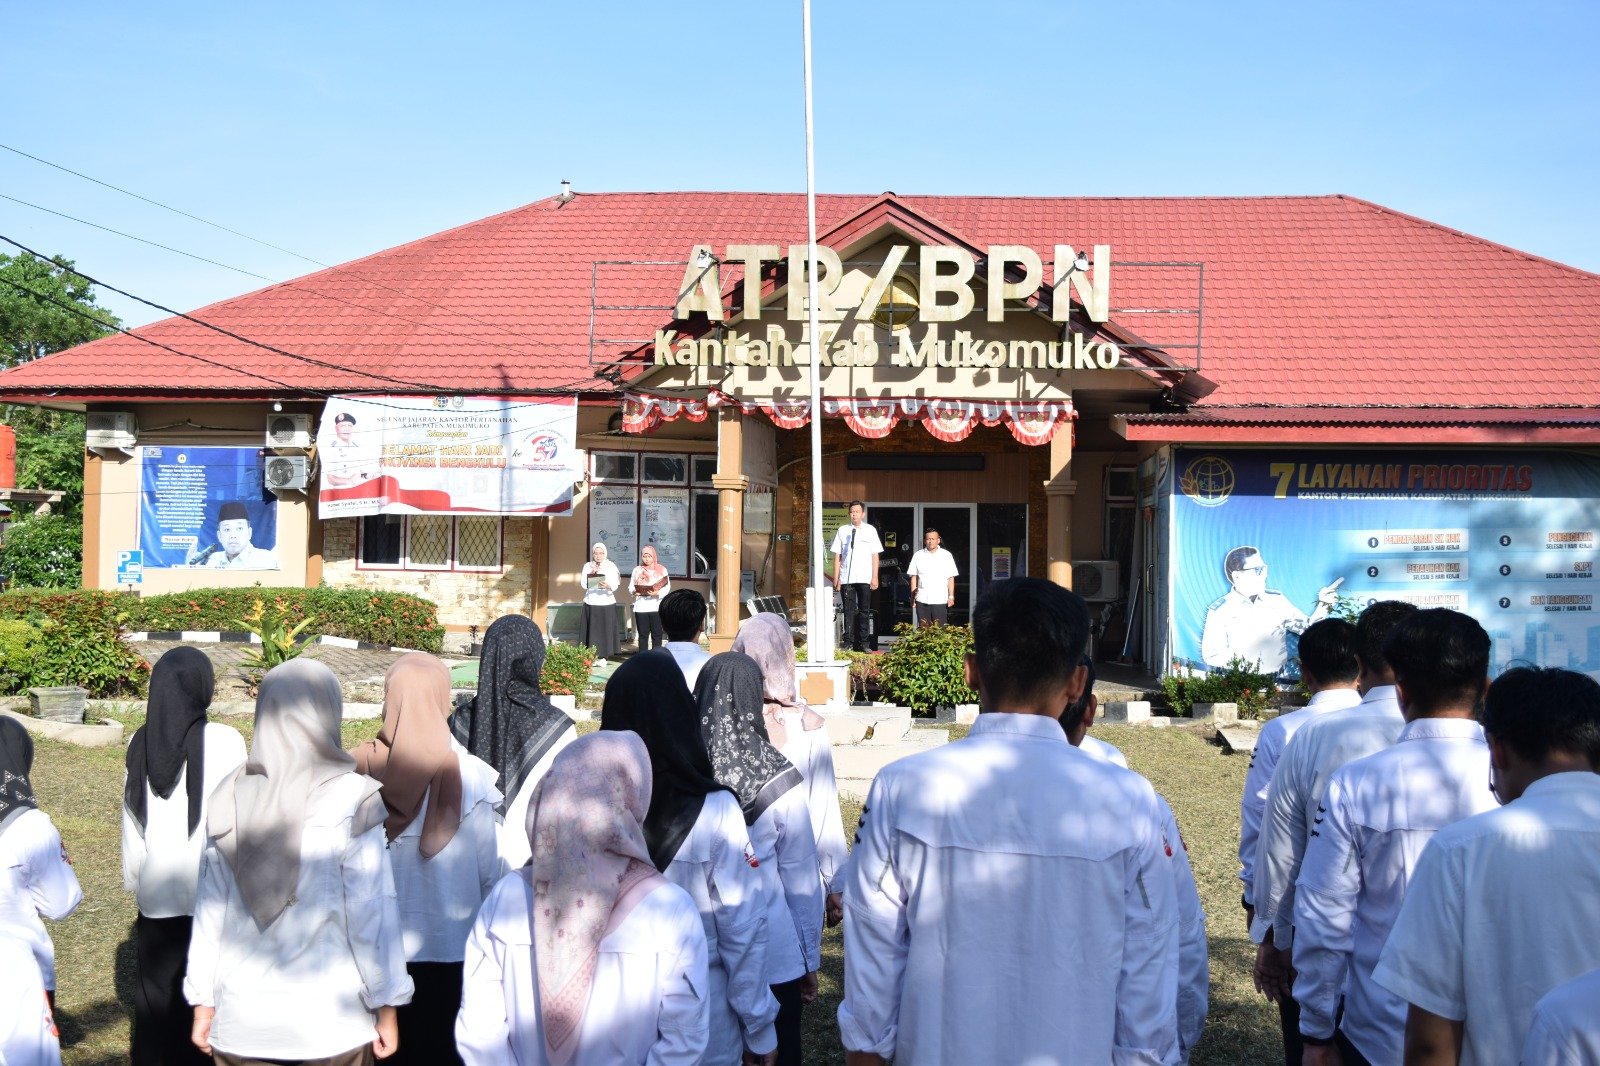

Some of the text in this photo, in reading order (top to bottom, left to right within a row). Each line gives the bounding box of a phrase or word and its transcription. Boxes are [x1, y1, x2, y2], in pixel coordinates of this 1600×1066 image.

[654, 329, 1120, 369] Kantah Kab Mukomuko
[381, 444, 504, 456] SELAMAT HARI JADI
[379, 457, 506, 468] PROVINSI BENGKULU
[1269, 463, 1533, 498] 7 LAYANAN PRIORITAS
[1298, 491, 1533, 501] KANTOR PERTANAHAN KABUPATEN MUKOMUKO
[1371, 538, 1376, 546] 1
[1384, 534, 1433, 544] PENDAFTARAN
[1446, 533, 1460, 543] HAK
[1548, 532, 1593, 542] PENGECEKAN
[1407, 563, 1460, 573] PERALIHAN HAK
[1574, 562, 1592, 571] SKPT
[1531, 595, 1592, 605] HAK TANGGUNGAN
